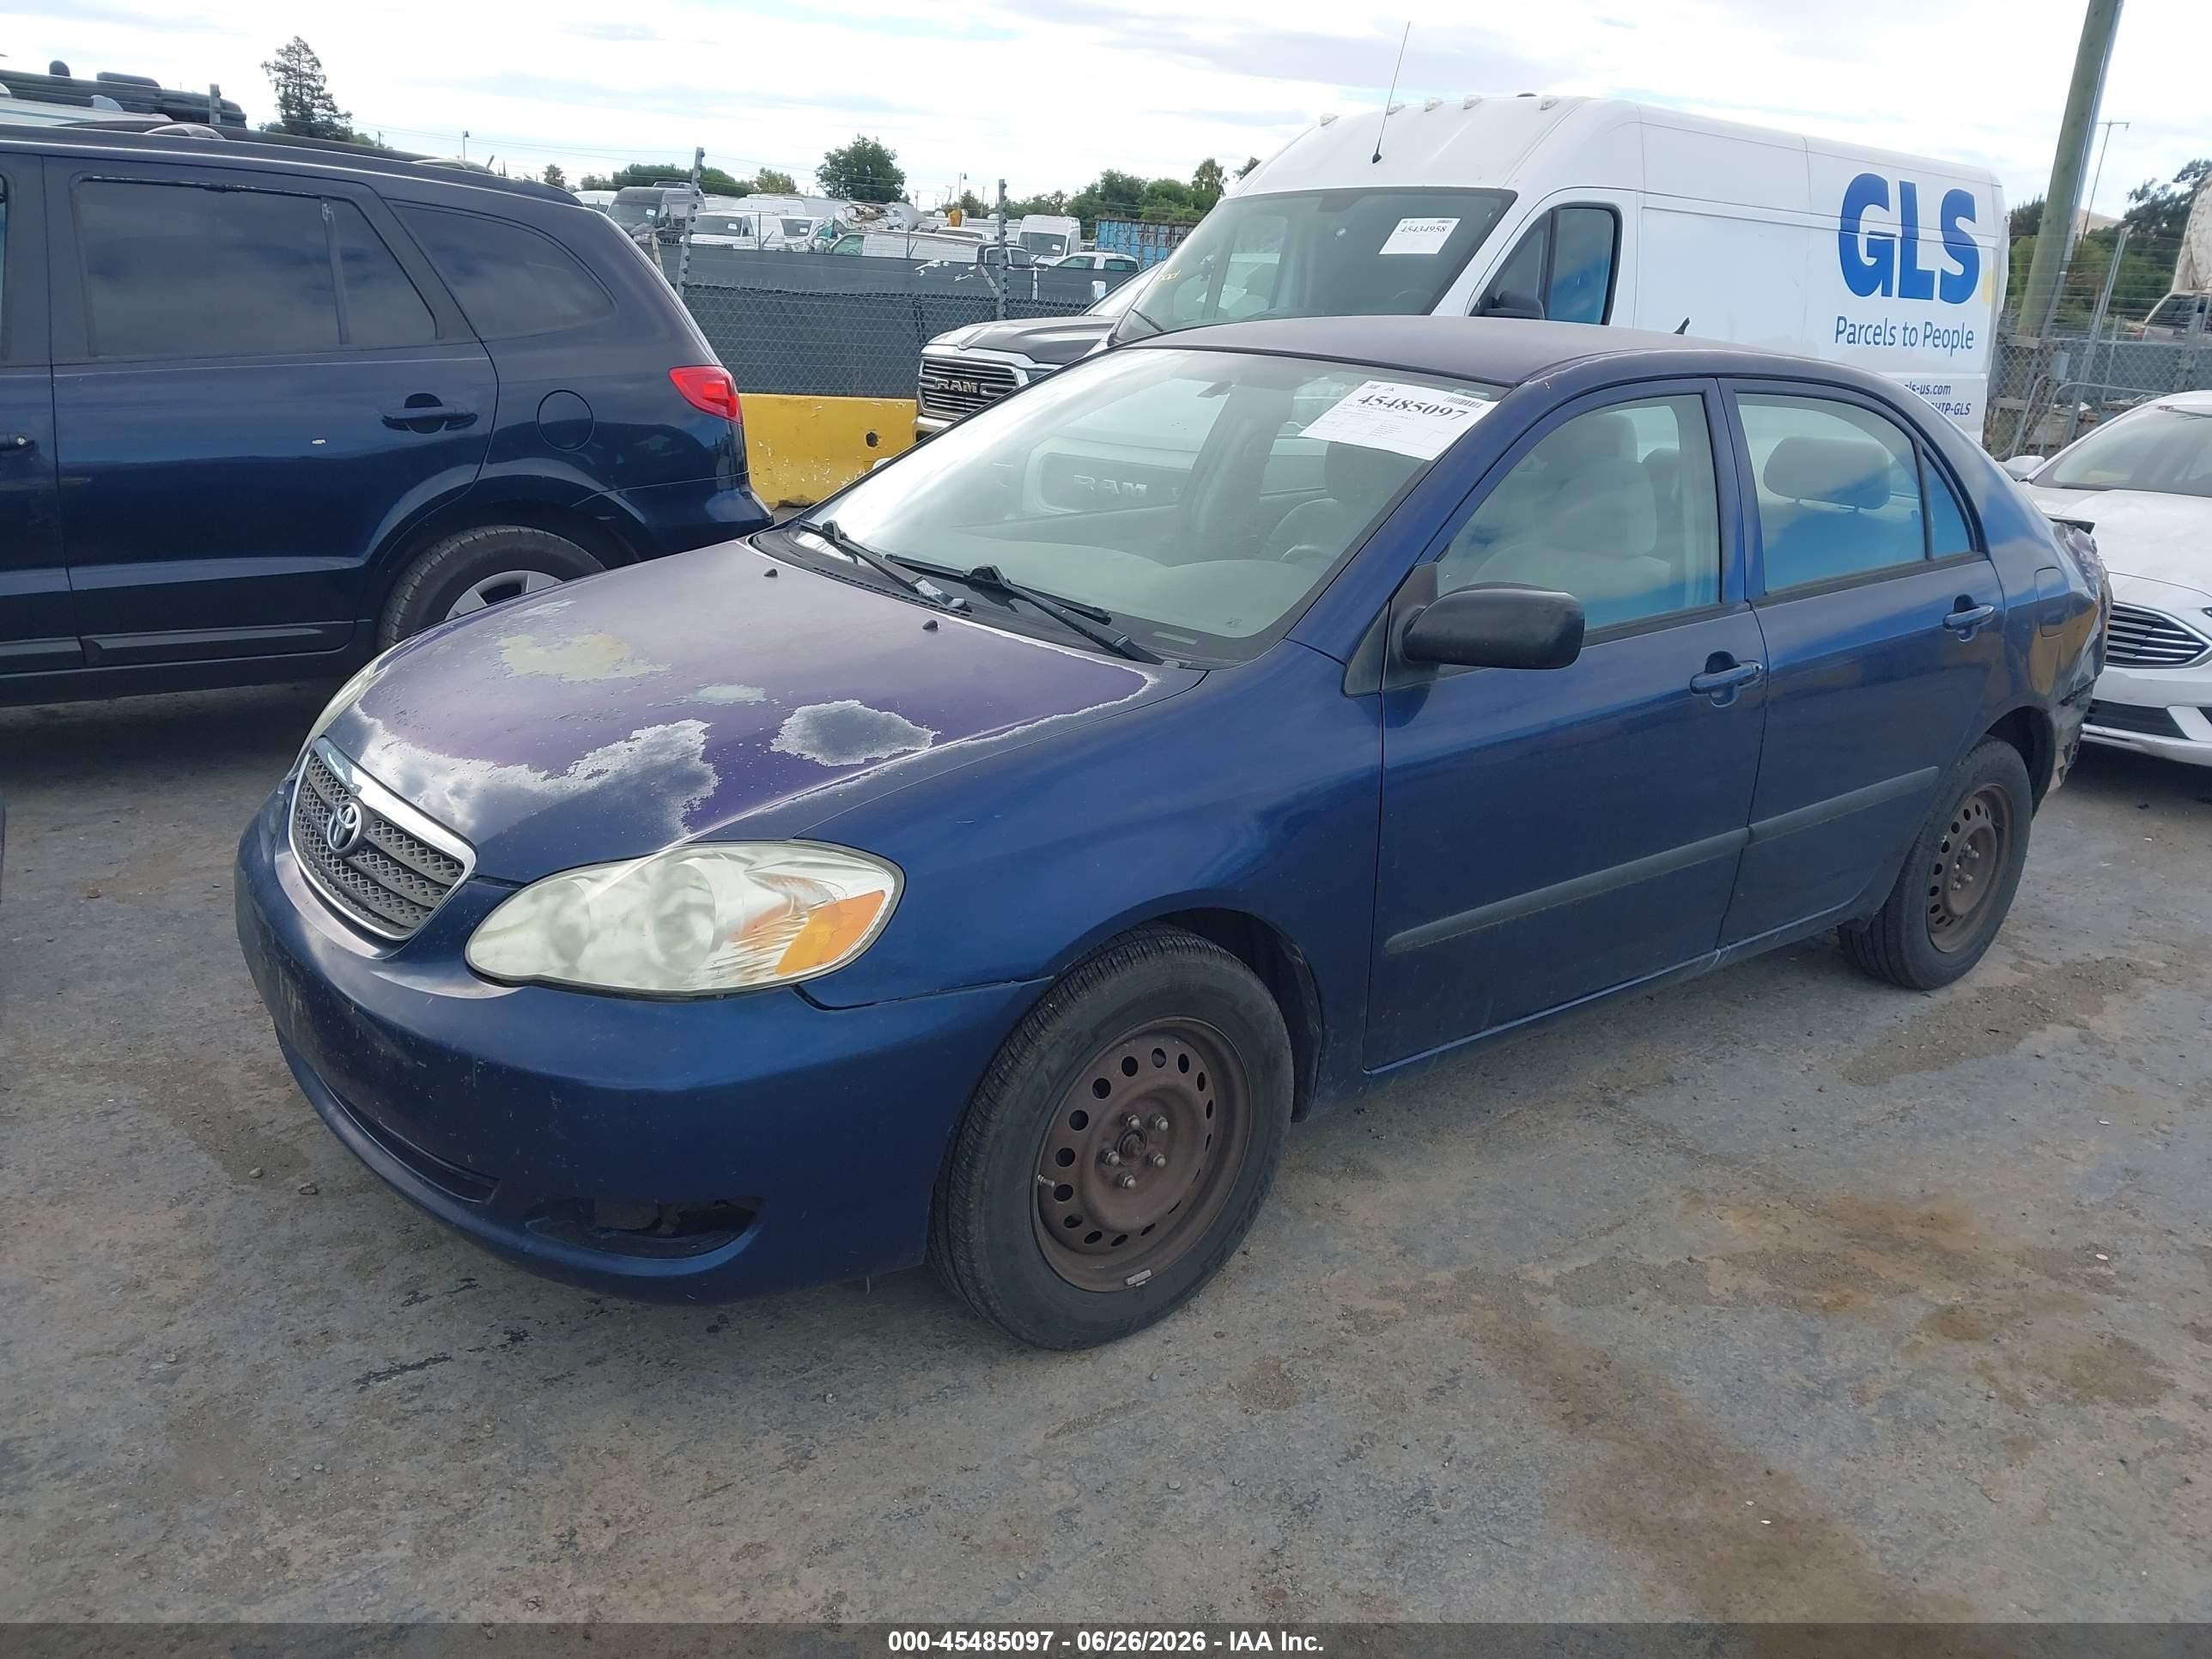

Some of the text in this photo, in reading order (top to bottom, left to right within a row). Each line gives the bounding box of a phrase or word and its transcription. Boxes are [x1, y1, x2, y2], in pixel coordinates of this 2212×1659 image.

[1401, 225, 1448, 234] 45434958
[1838, 173, 1980, 305] GLS
[1834, 315, 1974, 358] Parcels to People
[934, 378, 978, 393] RAM
[1357, 394, 1470, 421] 45485097
[1930, 402, 1972, 416] HIP-GLS
[1072, 474, 1148, 496] RAM
